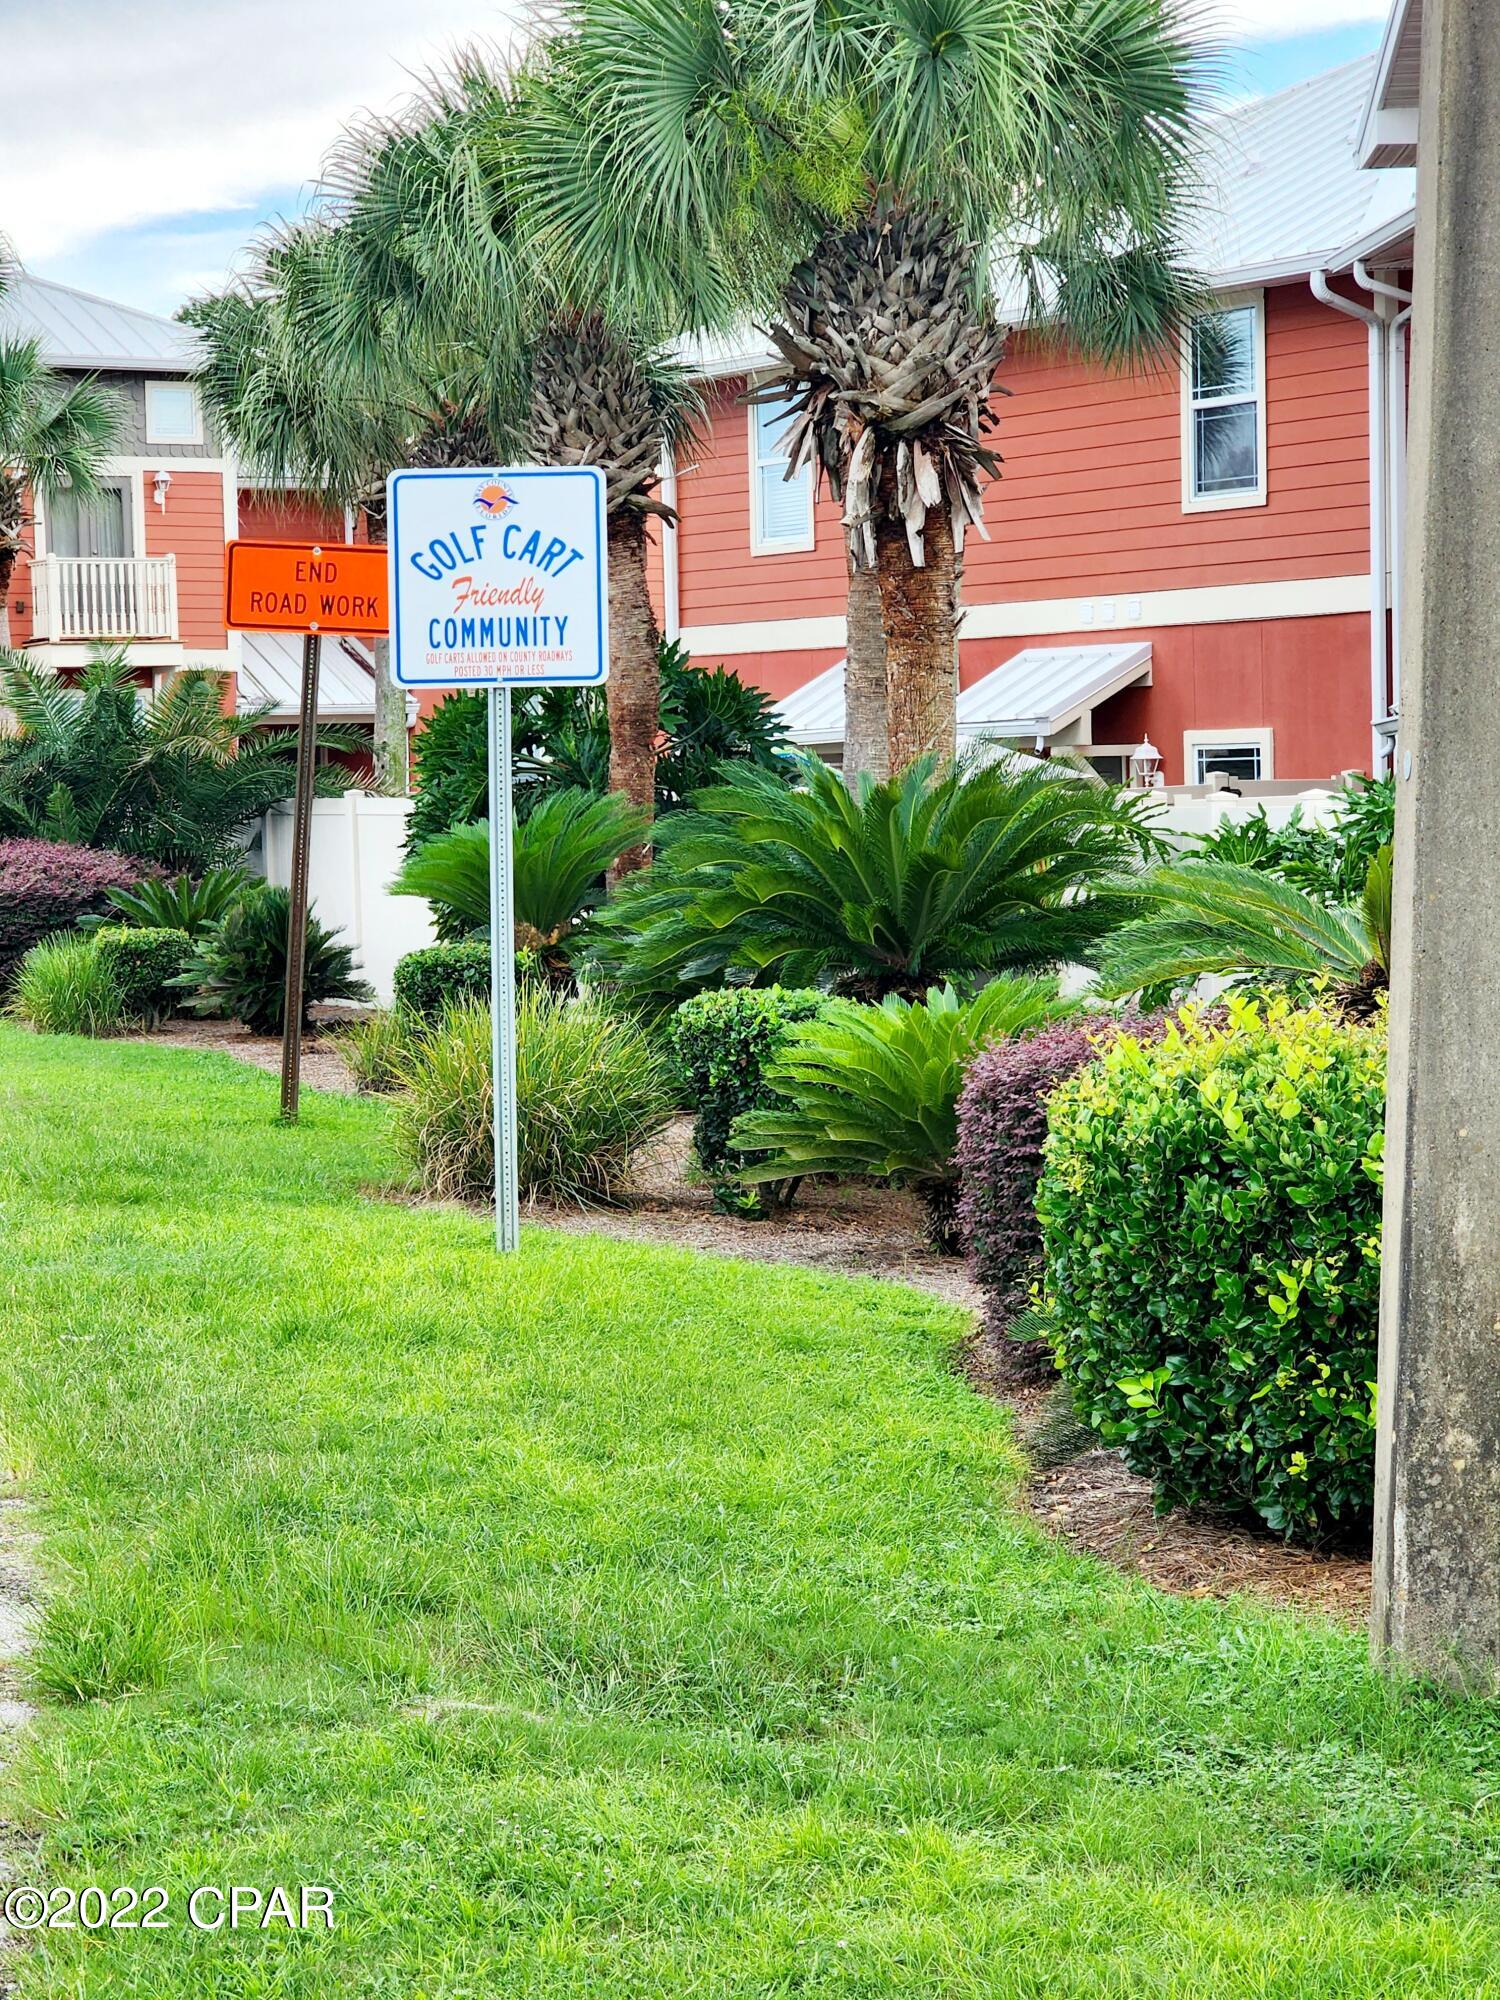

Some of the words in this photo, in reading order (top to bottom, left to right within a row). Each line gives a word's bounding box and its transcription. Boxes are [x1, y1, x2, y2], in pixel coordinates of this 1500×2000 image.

[410, 525, 486, 581] GOLF
[502, 524, 585, 578] CART
[295, 561, 337, 583] END
[250, 592, 307, 614] ROAD
[320, 594, 378, 617] WORK
[451, 576, 545, 614] Friendly
[429, 616, 568, 649] COMMUNITY
[426, 653, 443, 664] GOLF
[444, 652, 465, 664] CARTS
[466, 651, 496, 663] ALLOWED
[499, 651, 508, 662] ON
[510, 651, 537, 662] COUNTY
[538, 650, 573, 662] ROADWAYS
[454, 666, 481, 677] POSTED
[484, 665, 493, 676] 30
[496, 665, 512, 676] MPH
[514, 665, 525, 676] OR
[527, 664, 545, 675] LESS
